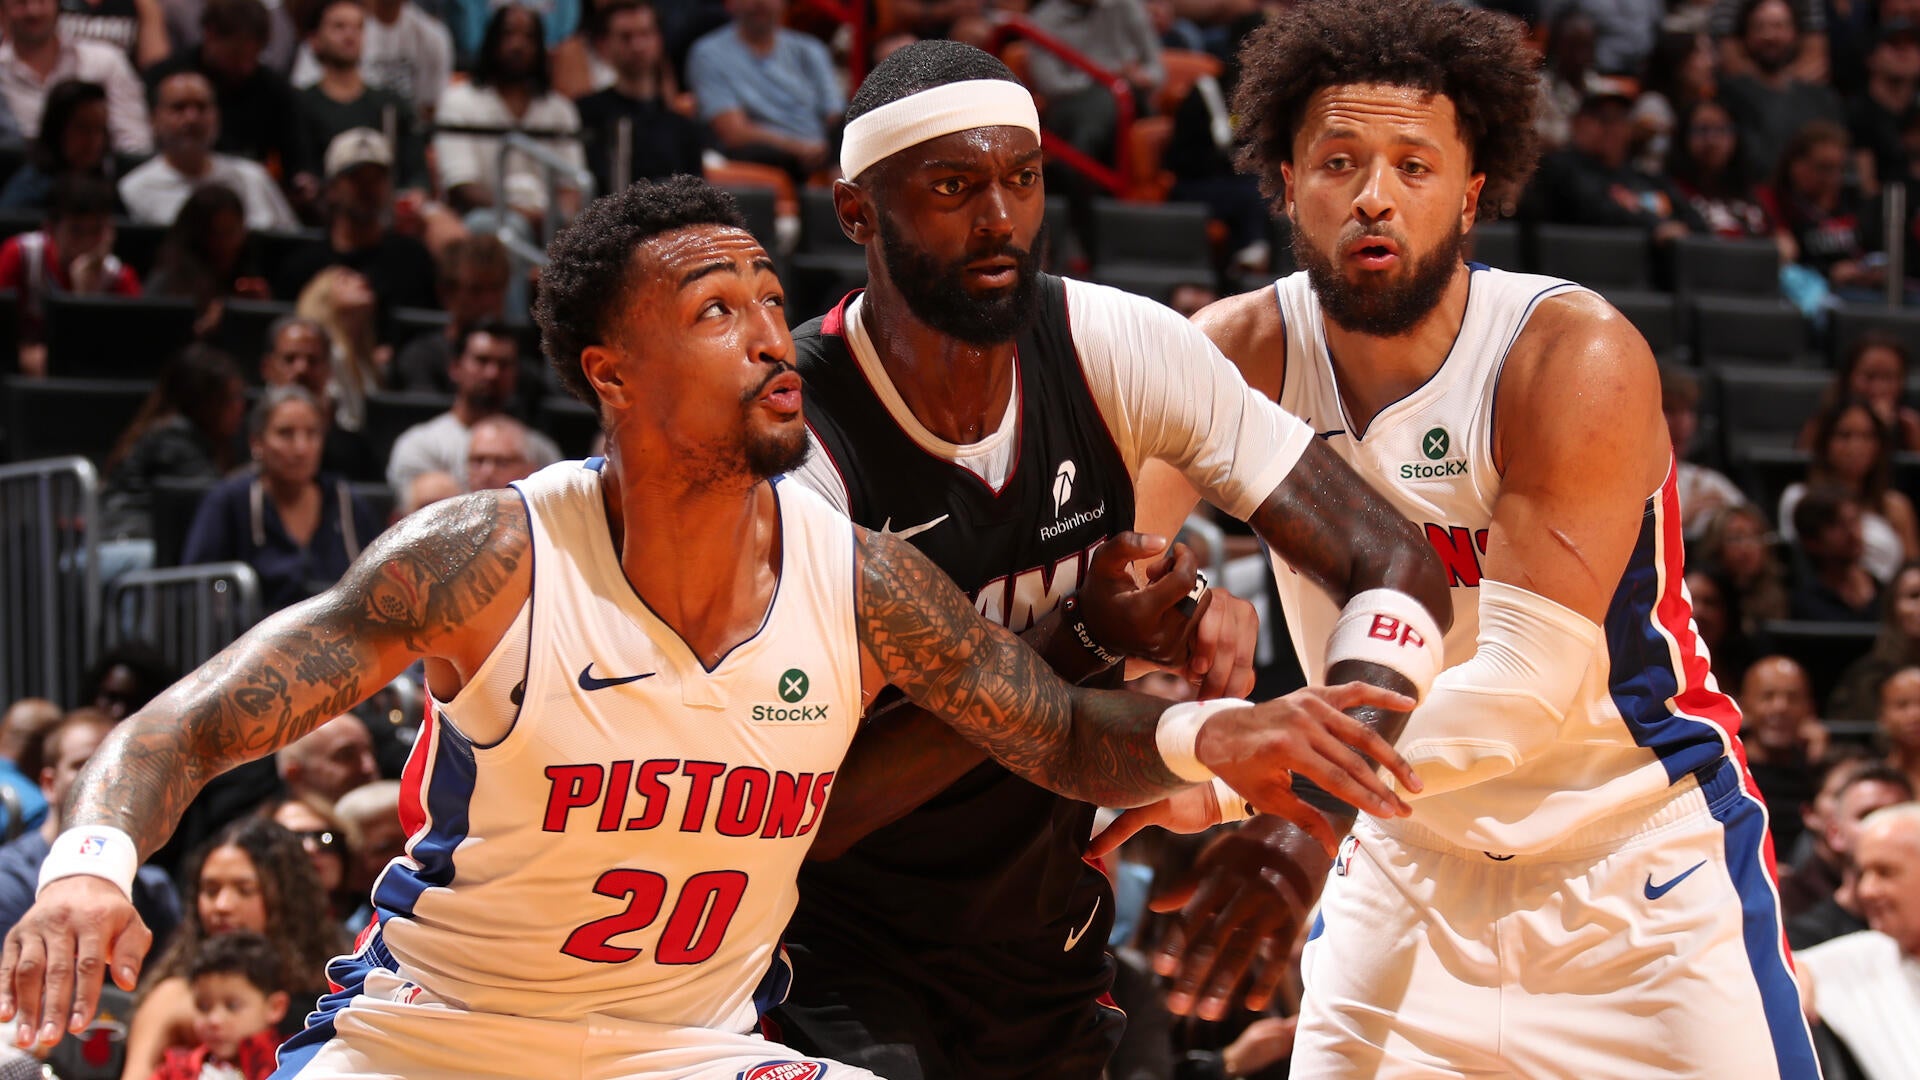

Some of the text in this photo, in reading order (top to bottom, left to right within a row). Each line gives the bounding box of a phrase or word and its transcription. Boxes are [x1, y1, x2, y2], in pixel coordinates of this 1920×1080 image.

[1400, 460, 1468, 479] StockX
[1040, 500, 1105, 541] Robinhood
[1073, 622, 1115, 663] Stay True
[1368, 613, 1424, 648] BP
[752, 704, 829, 721] StockX
[542, 759, 835, 839] PISTONS
[559, 868, 749, 965] 20
